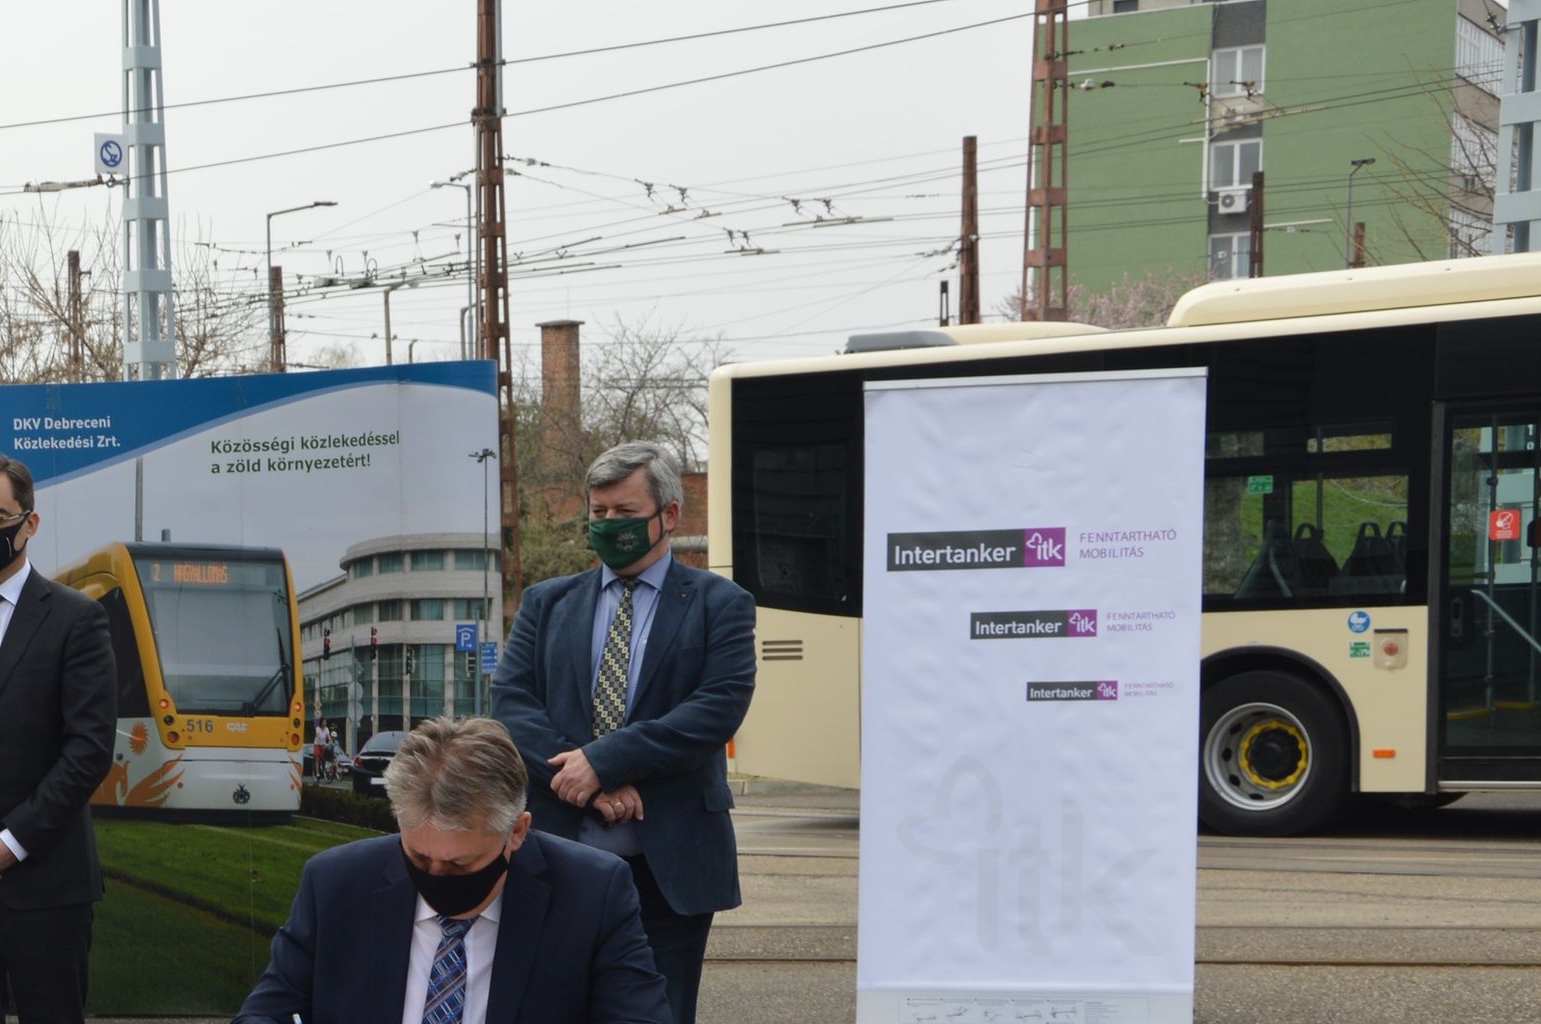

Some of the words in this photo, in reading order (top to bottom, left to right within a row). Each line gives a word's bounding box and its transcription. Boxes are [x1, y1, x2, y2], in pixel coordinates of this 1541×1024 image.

[13, 418, 41, 431] DKV
[44, 415, 111, 430] Debreceni
[14, 436, 94, 450] Közlekedési
[97, 435, 121, 448] Zrt.
[211, 436, 295, 454] Közösségi
[301, 430, 400, 450] közlekedéssel
[211, 463, 220, 474] a
[226, 458, 261, 474] zöld
[267, 452, 371, 473] környezetért!
[1079, 528, 1177, 543] FENNTARTHATÓ
[894, 543, 1017, 565] Intertanker
[1079, 545, 1145, 559] MOBILITÁS
[975, 619, 1063, 635] Intertanker
[461, 632, 471, 647] P
[1030, 687, 1094, 698] Intertanker
[187, 719, 214, 733] 516
